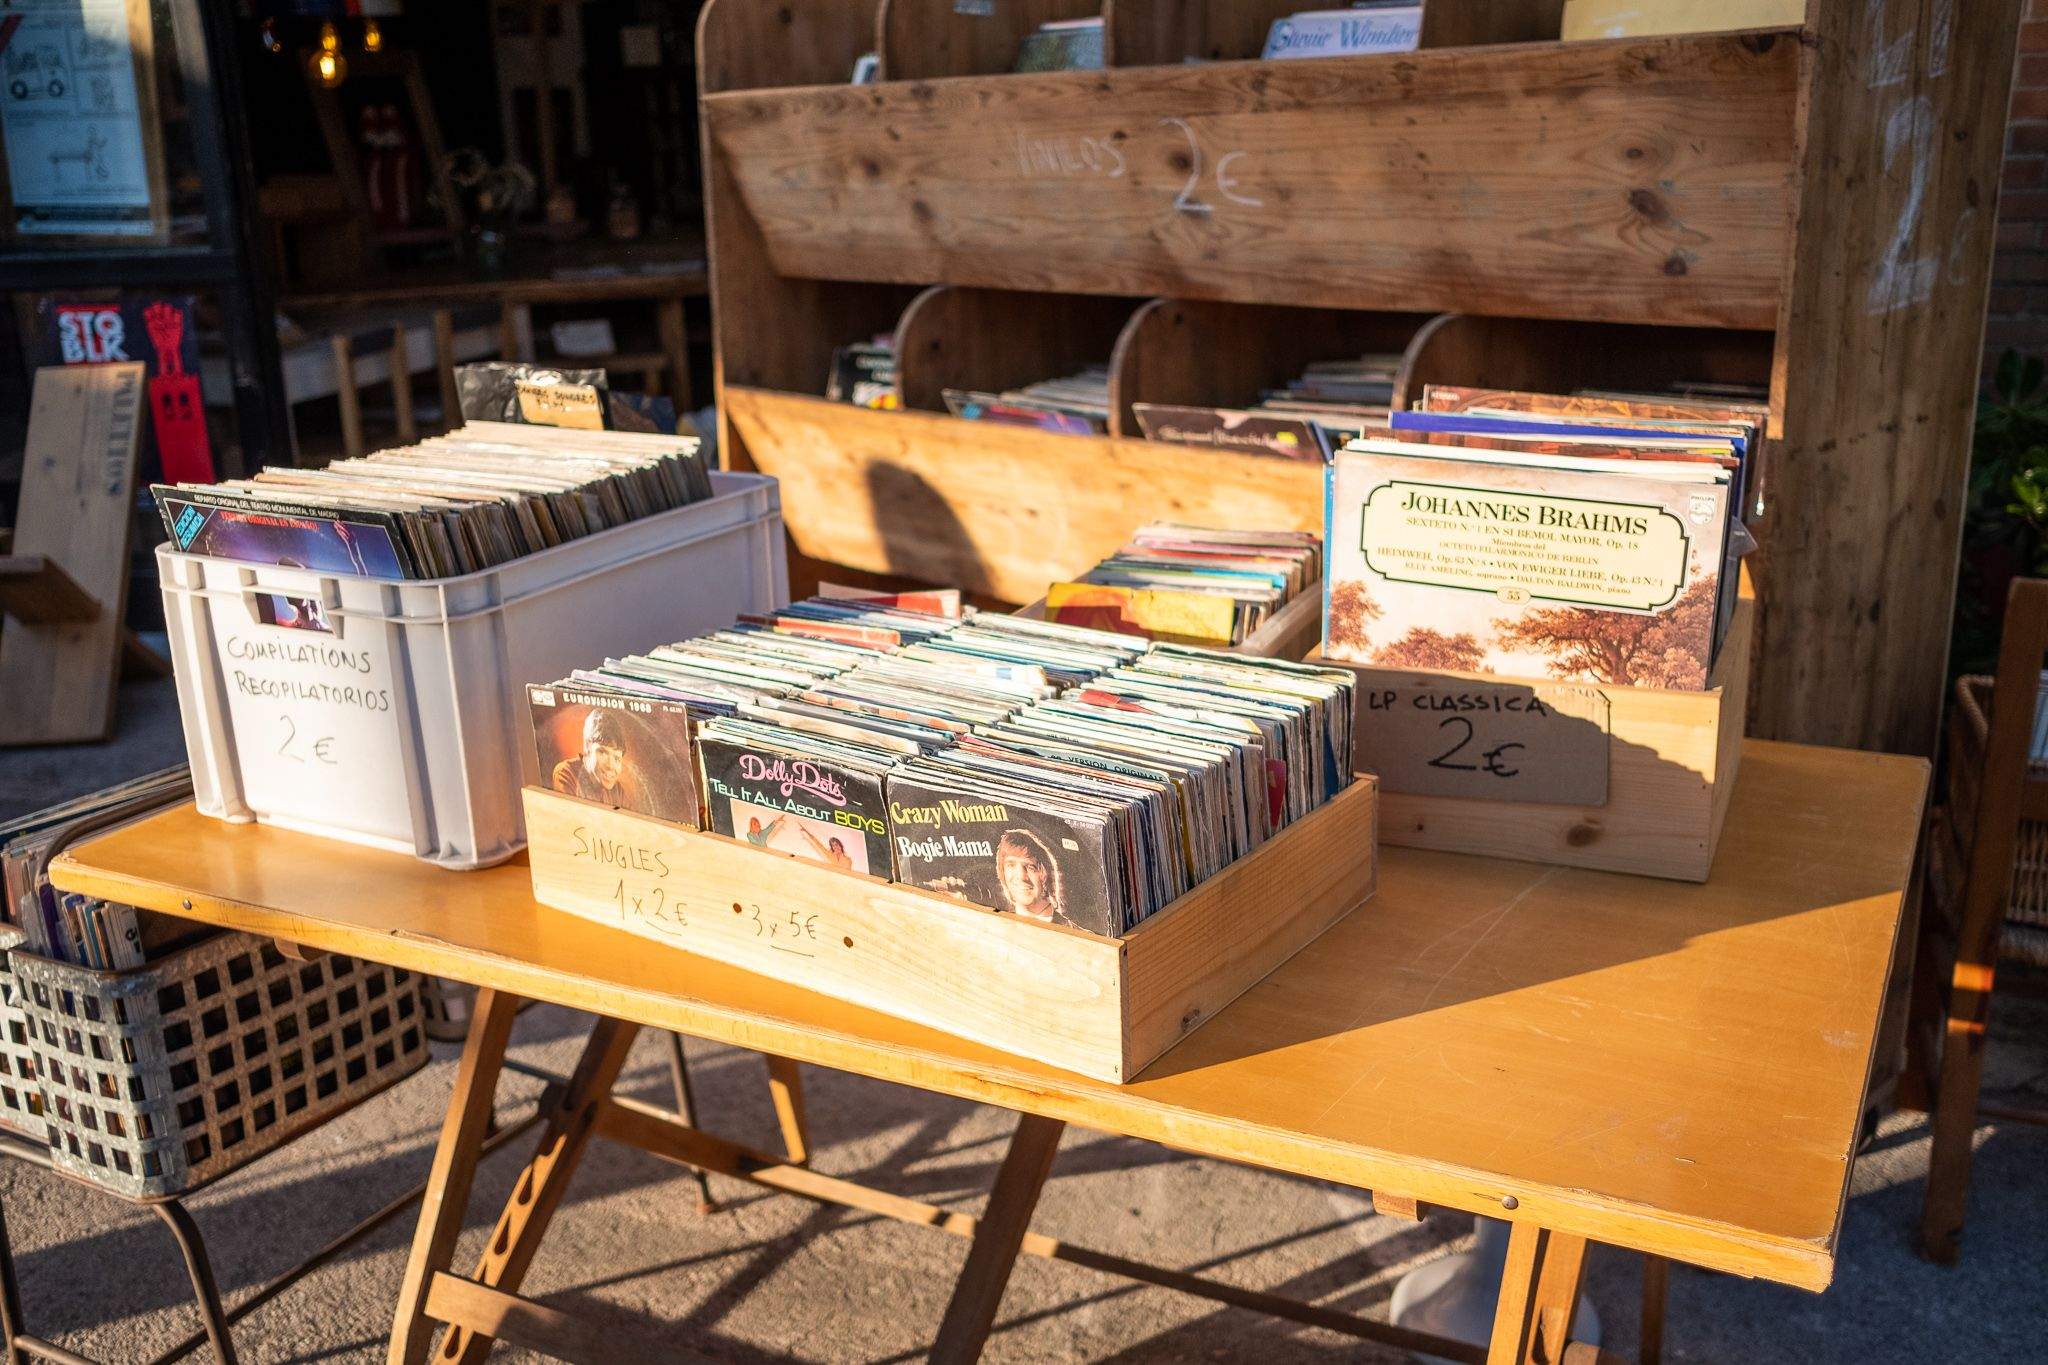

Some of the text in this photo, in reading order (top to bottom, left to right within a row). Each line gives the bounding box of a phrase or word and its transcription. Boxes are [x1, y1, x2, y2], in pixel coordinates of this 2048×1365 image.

[217, 497, 240, 508] ORIGINAL
[240, 500, 250, 509] DEL
[250, 501, 271, 511] TEATRO
[1401, 492, 1648, 535] JOHANNES BRAHMS
[1406, 516, 1457, 529] SEXTETO
[1486, 525, 1499, 535] EN
[1503, 528, 1514, 537] SI
[1518, 529, 1556, 541] BEMOL
[1561, 533, 1602, 547] MAYOR,
[1606, 538, 1623, 550] Op.
[1628, 540, 1639, 550] 18
[1491, 538, 1546, 551] Miembros del
[1439, 541, 1477, 551] OCTETO
[1547, 552, 1560, 561] DE
[1562, 554, 1599, 565] BERLIN
[1431, 565, 1473, 577] AMELING,
[1476, 573, 1508, 581] soprano
[1517, 575, 1554, 585] DALTON
[1557, 579, 1605, 592] BALDWIN,
[1607, 587, 1631, 595] piano
[1496, 560, 1518, 570] VON
[1522, 563, 1567, 576] EWIGER
[1570, 568, 1607, 581] LIEBE,
[1611, 573, 1628, 584] Op.
[227, 635, 371, 674] COMPILATIONS
[234, 670, 389, 712] RECOPILATORIOS
[562, 693, 625, 710] EUROVISION
[629, 702, 652, 713] 1968
[1369, 691, 1397, 710] LP
[1412, 693, 1548, 717] CLASSICA
[739, 754, 848, 801] Dolly Dots
[1068, 756, 1108, 770] VERSION
[709, 777, 886, 835] TELL IT ALL ABOUT BOYS
[891, 799, 1009, 829] Crazy Woman
[573, 826, 670, 878] SINGLES
[896, 835, 994, 863] Bogie Mama
